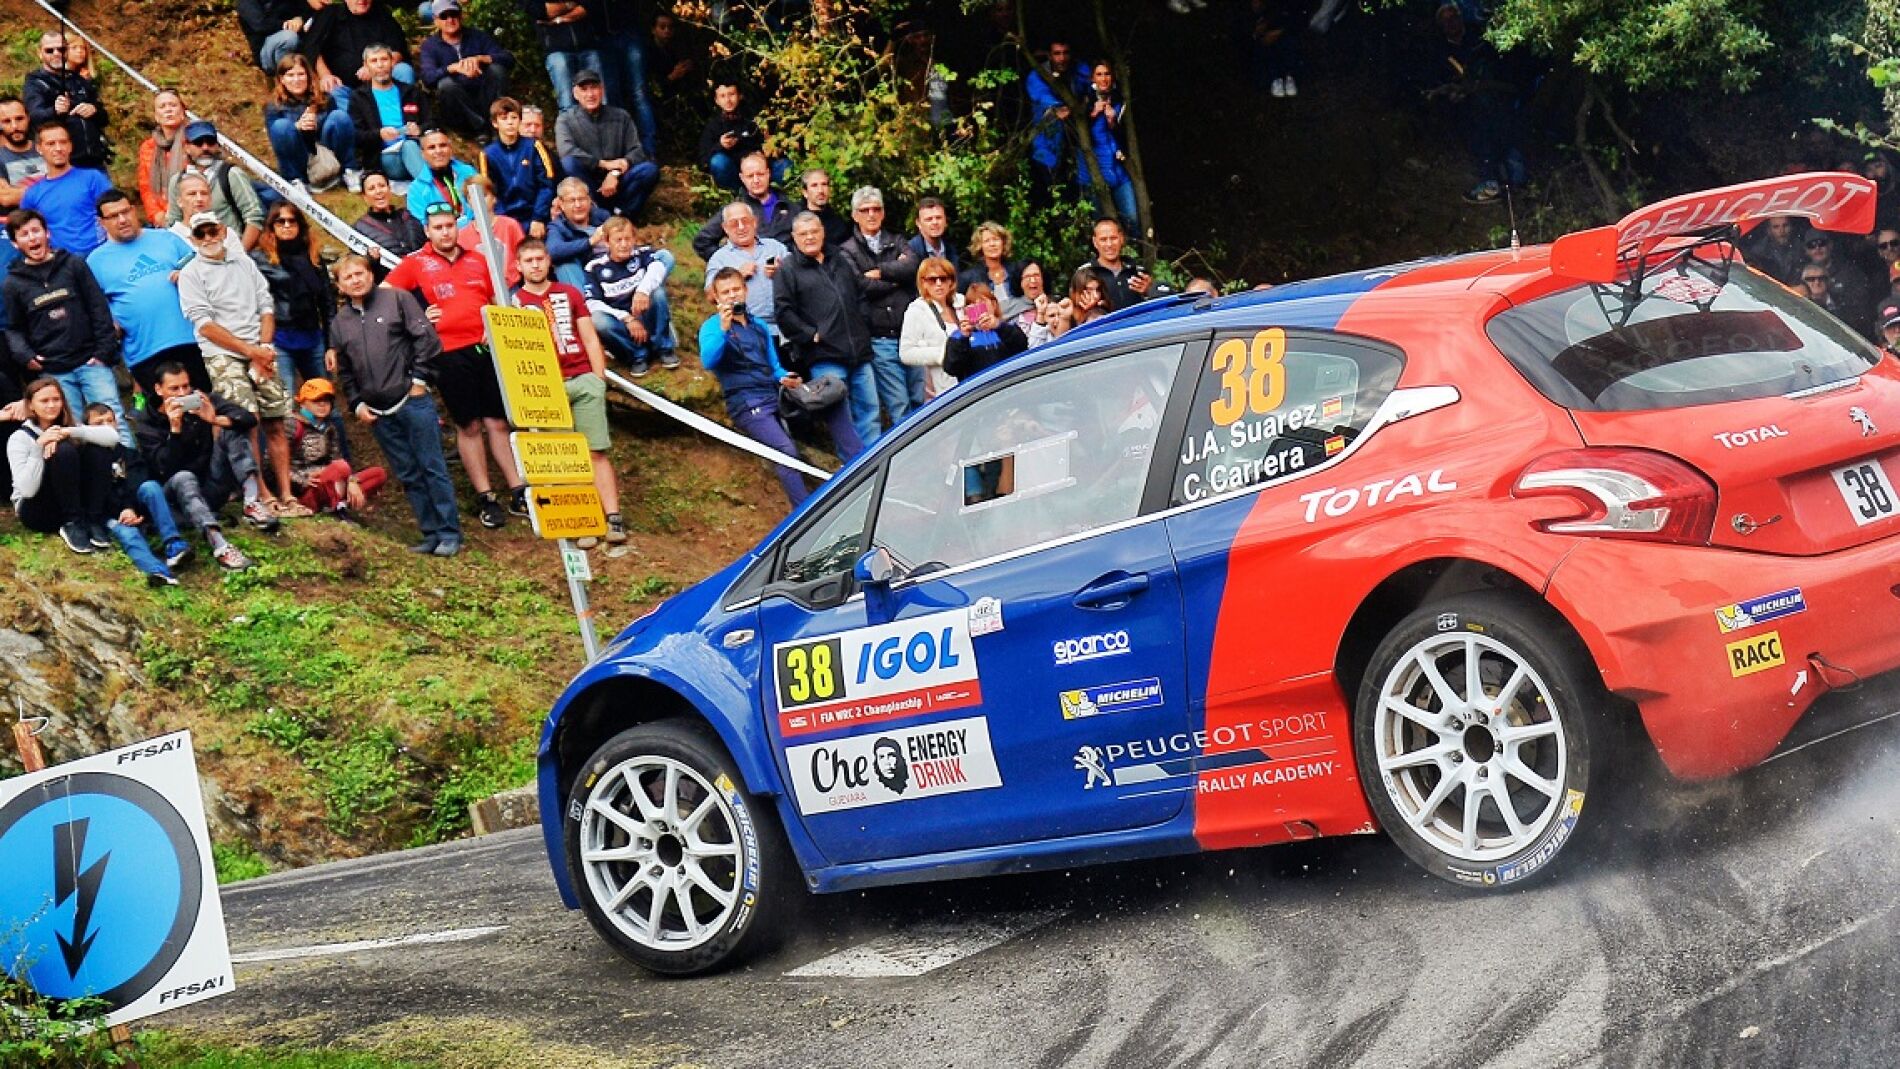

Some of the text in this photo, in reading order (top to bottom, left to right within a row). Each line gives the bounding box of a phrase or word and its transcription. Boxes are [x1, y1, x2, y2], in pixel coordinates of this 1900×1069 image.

[1617, 181, 1872, 246] PEUGEOT
[128, 263, 168, 282] adidas
[1211, 327, 1286, 427] 38
[1230, 402, 1318, 448] Suarez
[1713, 424, 1789, 449] TOTAL
[1183, 446, 1305, 501] C. Carrera
[1299, 469, 1457, 523] TOTAL
[1842, 464, 1893, 519] 38
[1751, 594, 1803, 615] MICHELIN
[856, 626, 959, 684] IGOL
[1053, 630, 1130, 663] sparco
[1732, 637, 1782, 670] RACC
[786, 643, 835, 702] 38
[1097, 684, 1160, 705] MICHELIN
[820, 711, 834, 723] FIA
[835, 709, 854, 721] WRC
[855, 706, 862, 718] 2
[863, 696, 922, 716] Championship
[907, 728, 968, 763] ENERGY
[1106, 711, 1328, 763] PEUGEOT SPORT
[810, 747, 870, 793] Che
[911, 757, 969, 790] DRINK
[1199, 773, 1248, 794] RALLY
[828, 790, 868, 807] GUEVARA
[734, 803, 759, 888] MICHELIN
[1502, 823, 1570, 881] MICHELIN
